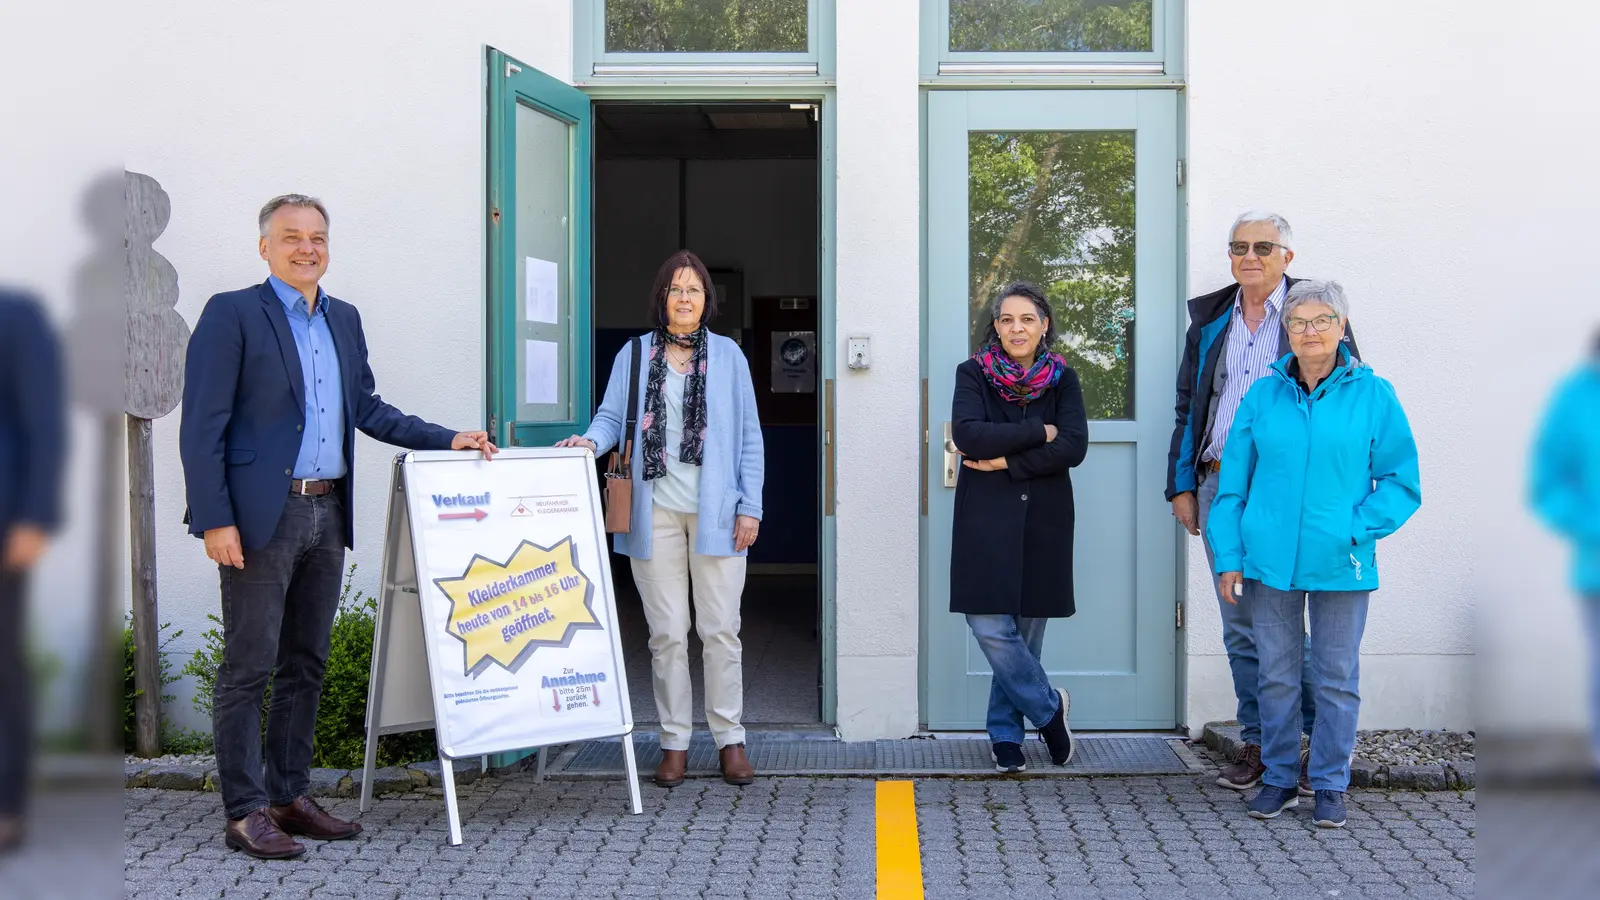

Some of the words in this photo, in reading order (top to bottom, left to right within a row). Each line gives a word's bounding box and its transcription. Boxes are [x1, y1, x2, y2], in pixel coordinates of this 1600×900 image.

[432, 492, 491, 508] Verkauf
[467, 561, 557, 607] Kleiderkammer
[457, 614, 490, 635] heute
[490, 604, 511, 620] von
[513, 596, 528, 612] 14
[529, 592, 544, 604] bis
[544, 583, 560, 598] 16
[559, 575, 579, 591] Uhr
[501, 607, 556, 642] geöffnet.
[541, 671, 606, 689] Annahme
[576, 685, 591, 693] 25m
[566, 694, 587, 702] zurück
[566, 701, 588, 710] gehen.
